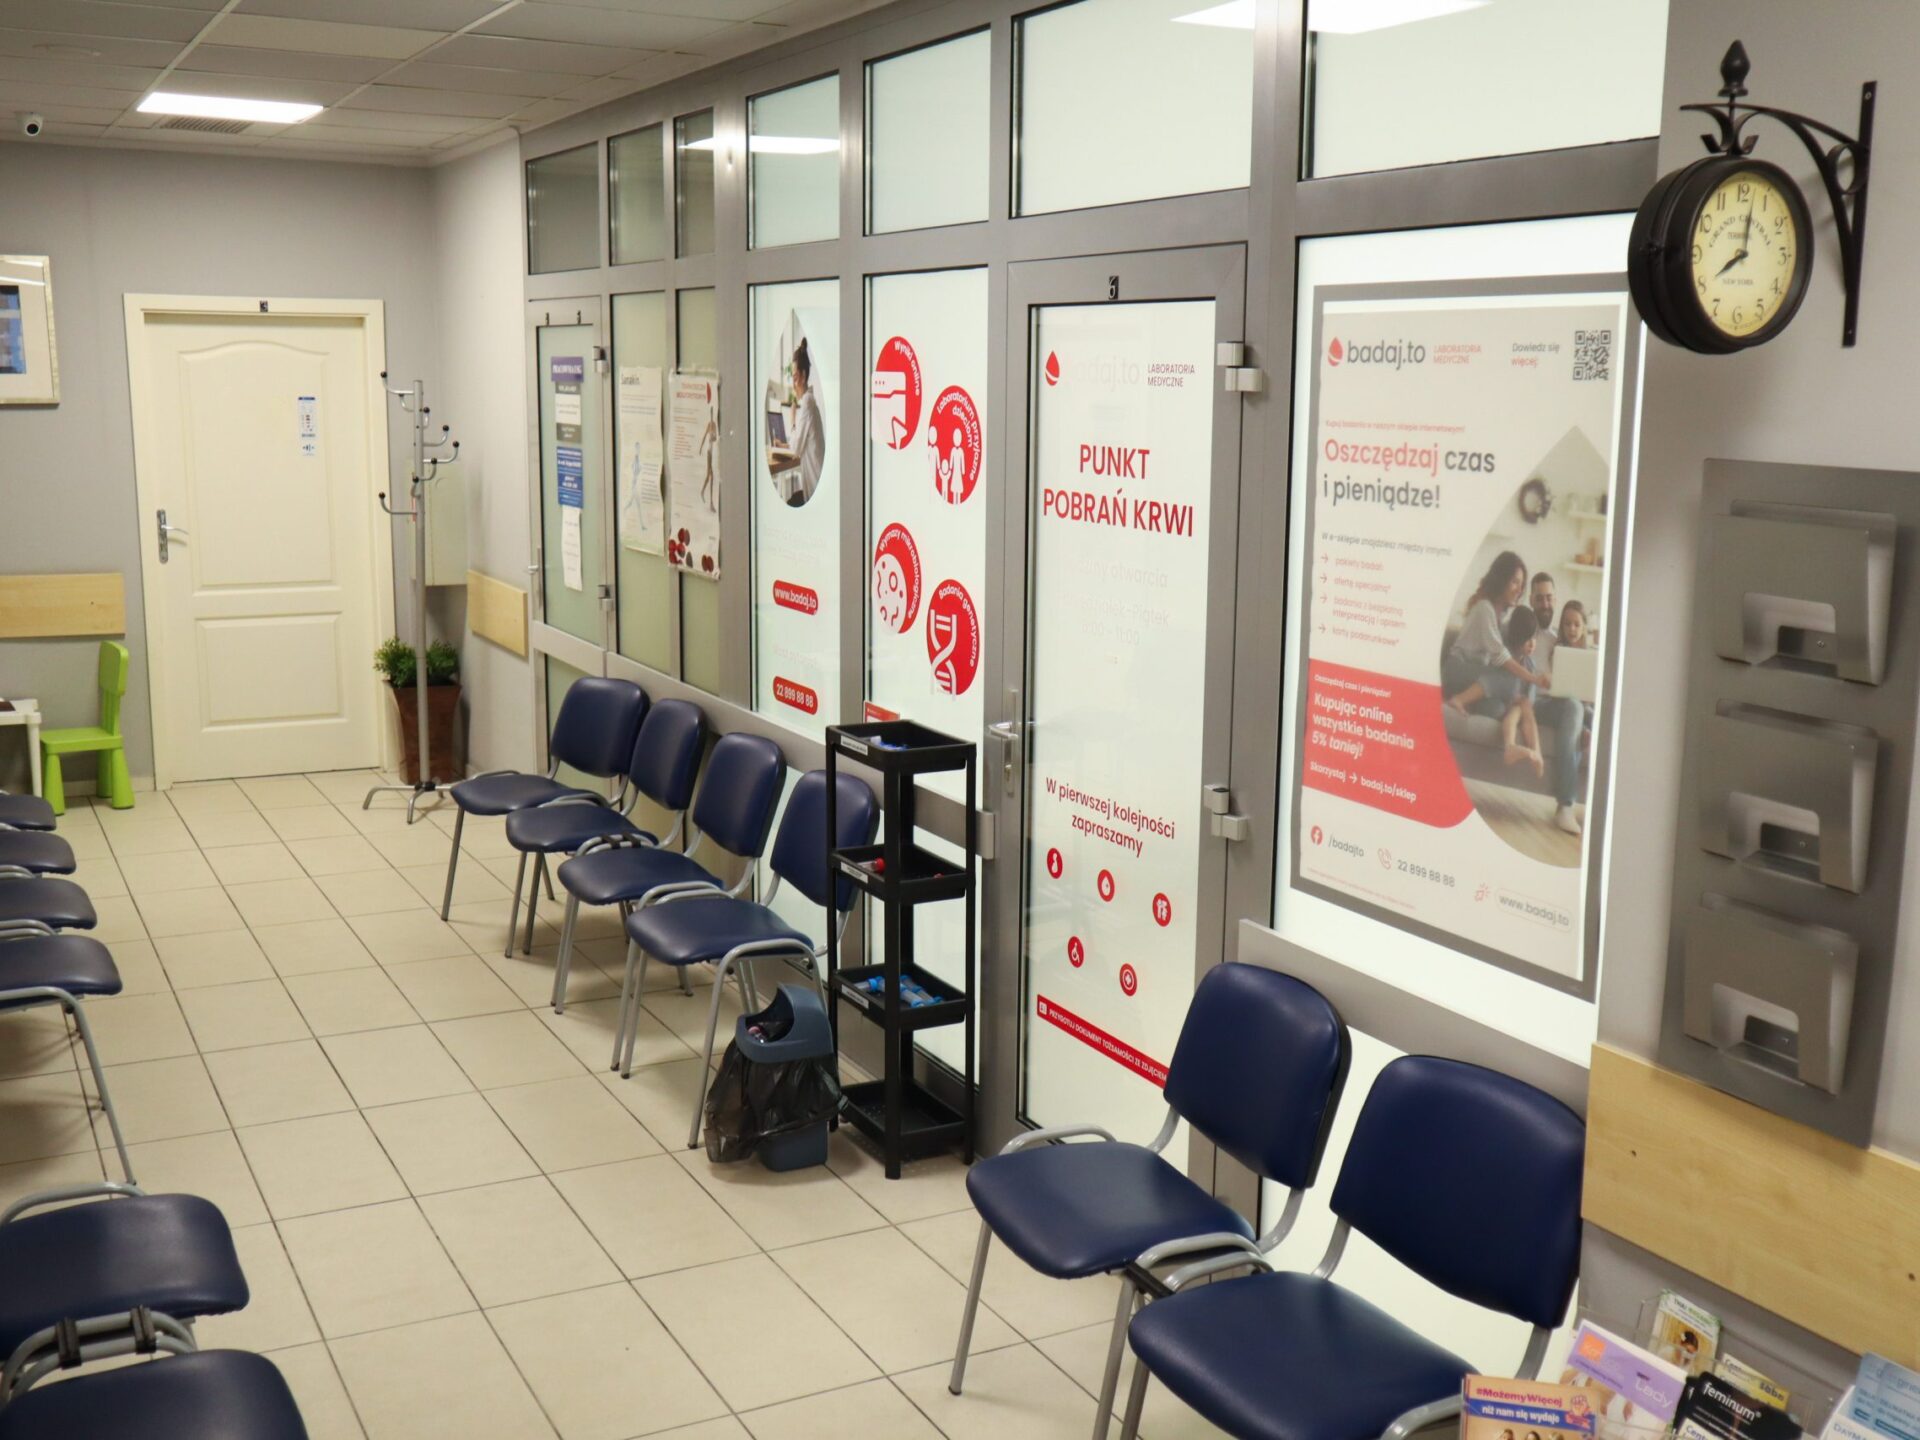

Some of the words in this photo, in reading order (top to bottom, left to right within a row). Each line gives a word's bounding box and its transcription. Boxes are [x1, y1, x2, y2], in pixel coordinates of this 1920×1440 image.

[1716, 191, 1727, 211] 11
[1736, 183, 1750, 203] 12
[1762, 193, 1768, 212] 1
[1700, 213, 1713, 234] 10
[1774, 215, 1785, 235] 2
[1692, 244, 1703, 265] 9
[1777, 246, 1787, 266] 3
[1697, 275, 1707, 295] 8
[1769, 277, 1781, 293] 4
[1712, 297, 1721, 317] 7
[1732, 306, 1743, 324] 6
[1755, 297, 1765, 320] 5
[1347, 339, 1426, 370] badaj.to
[1433, 355, 1470, 364] MEDYCZNE
[1434, 344, 1481, 354] LABORATORIA
[1512, 342, 1546, 353] Dowiedz
[1548, 343, 1560, 354] się
[894, 341, 913, 362] Wyniki
[911, 360, 921, 397] online
[1148, 363, 1195, 376] LABORATORIA
[1147, 376, 1184, 388] MEDYCZNE
[937, 392, 975, 420] Laboratorium
[969, 420, 981, 481] przyjazne
[952, 405, 973, 448] dzieciom
[1079, 444, 1151, 479] PUNKT
[1325, 438, 1439, 477] Oszczędzaj
[1444, 448, 1496, 473] czas
[1323, 473, 1328, 498] i
[1333, 475, 1441, 512] pieniądze!
[1043, 487, 1127, 527] POBRAŃ
[1133, 500, 1194, 537] KRWI
[1322, 532, 1328, 540] W
[1329, 533, 1360, 546] e-sklepie
[1360, 538, 1396, 549] znajdziesz
[1397, 542, 1424, 554] między
[901, 531, 921, 619] mikrobiologiczne
[774, 585, 817, 611] www.badaj.to
[939, 585, 964, 601] Badania
[961, 597, 977, 667] genetyczne
[1332, 608, 1375, 626] interpretacją
[776, 683, 783, 696] 22
[784, 686, 795, 701] 899
[796, 690, 805, 705] 88
[805, 694, 814, 708] 88
[1314, 693, 1357, 717] Kupując
[1359, 706, 1393, 724] online
[1312, 713, 1363, 736] wszystkie
[1365, 725, 1415, 750] badania
[1312, 730, 1327, 747] 5%
[1328, 736, 1364, 760] taniej!
[1309, 761, 1346, 784] Skorzystaj
[1360, 776, 1417, 804] badaj.to/sklep
[1045, 777, 1057, 794] W
[1059, 783, 1111, 821] pierwszej
[1113, 799, 1176, 840] kolejności
[1071, 814, 1144, 858] zapraszamy
[1328, 829, 1365, 857] /badajto
[1397, 860, 1408, 872] 22
[1410, 861, 1427, 878] 899
[1429, 868, 1441, 883] 88
[1443, 871, 1455, 888] 88
[1499, 894, 1569, 927] www.badaj.to
[1049, 1008, 1075, 1029] PRZYGOTUJ
[1075, 1022, 1102, 1045] DOKUMENT
[1102, 1039, 1135, 1063] TOŻSAMOŚCI
[1135, 1056, 1141, 1067] ZE
[1476, 1387, 1563, 1408] #MożemyWięcej
[1482, 1405, 1495, 1415] niż
[1496, 1408, 1514, 1418] nam
[1516, 1410, 1528, 1421] się
[1530, 1412, 1560, 1425] wydaje
